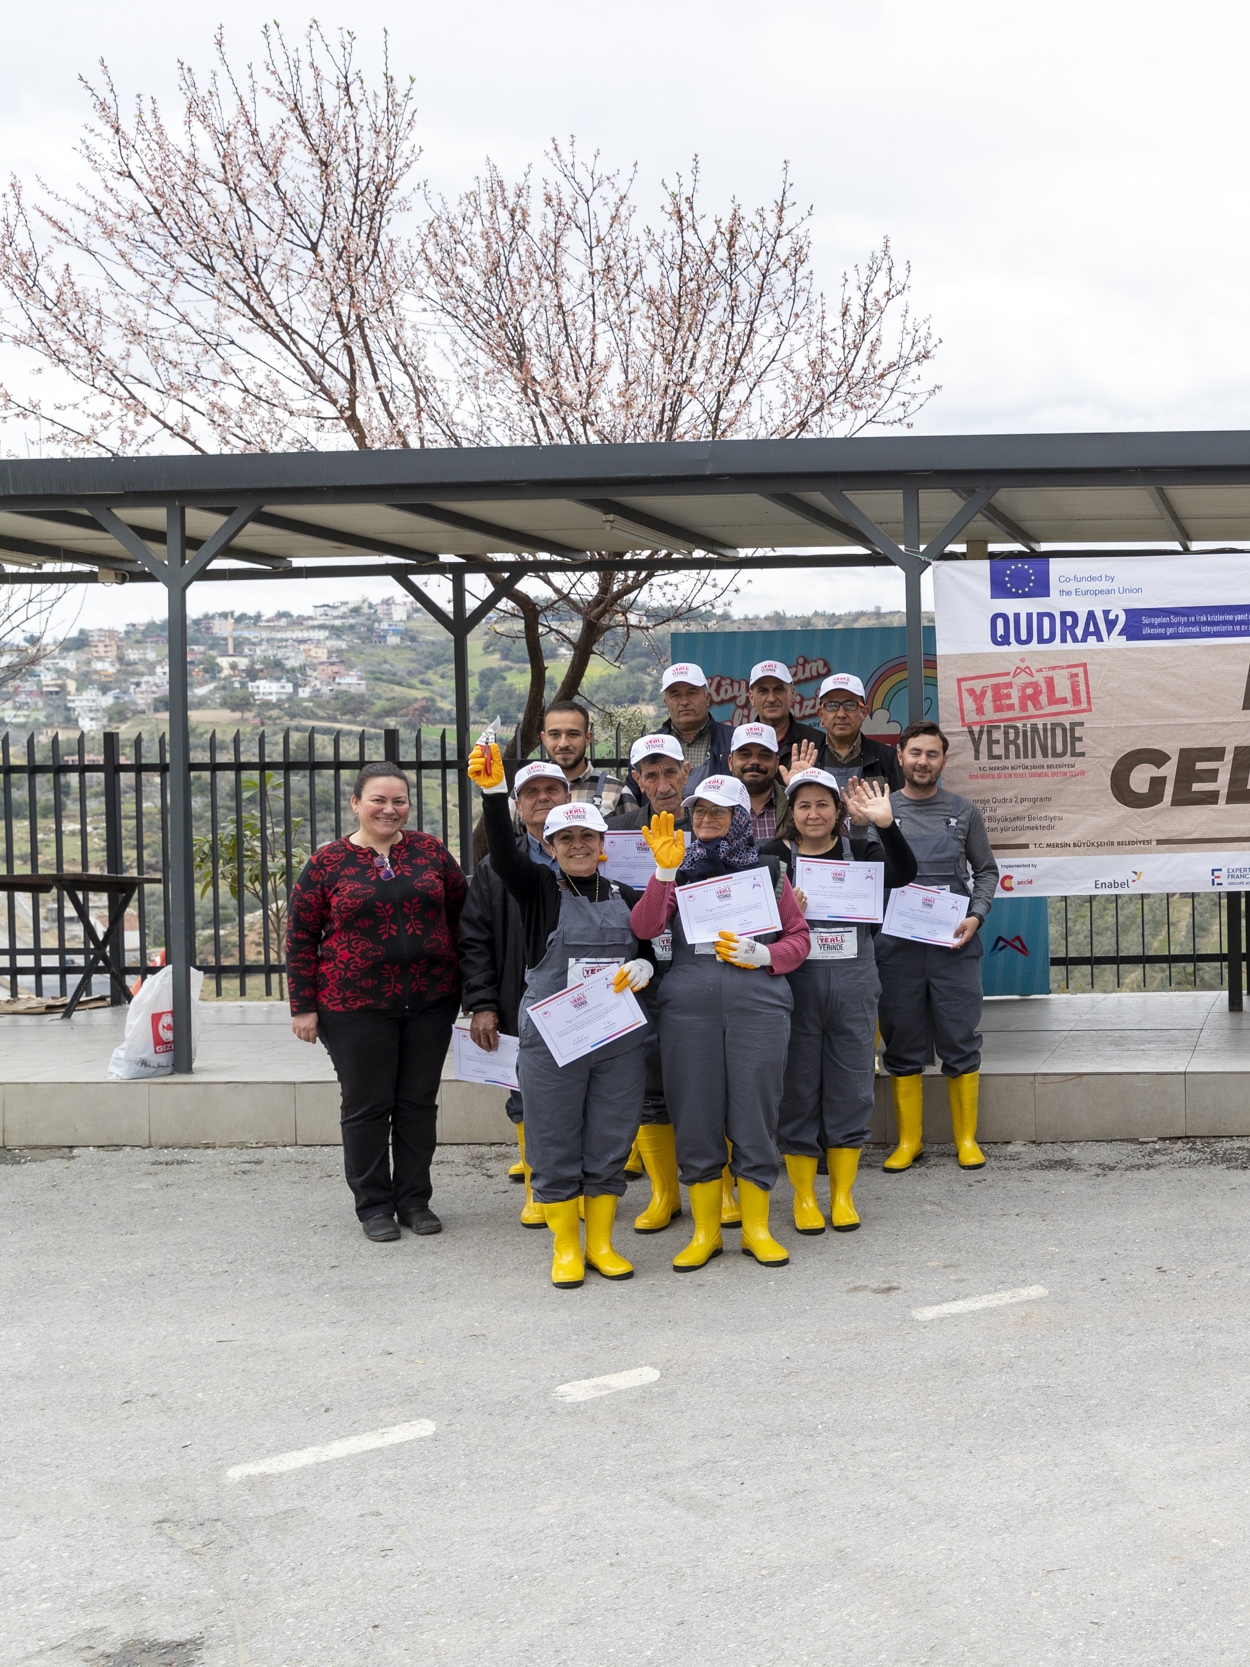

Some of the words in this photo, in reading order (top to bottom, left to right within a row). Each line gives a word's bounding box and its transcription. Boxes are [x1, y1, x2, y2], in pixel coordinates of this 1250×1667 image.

[1058, 574, 1103, 583] Co-funded
[1105, 574, 1115, 583] by
[1059, 589, 1072, 597] the
[1075, 588, 1116, 597] European
[1118, 586, 1143, 594] Union
[1141, 615, 1170, 625] Süregelen
[1170, 614, 1188, 624] Suriye
[1196, 614, 1207, 622] Irak
[1207, 613, 1234, 622] krizlerine
[1234, 613, 1248, 622] yanıt
[1142, 626, 1165, 634] ülkesine
[1166, 627, 1177, 635] geri
[1178, 625, 1200, 633] dönmek
[1200, 624, 1233, 633] isteyenlerin
[967, 722, 1086, 761] YERİNDE
[1011, 763, 1045, 771] BÜYÜKŞEHİR
[1020, 797, 1052, 805] programı
[987, 815, 1026, 824] Büyükşehir
[1027, 813, 1063, 823] Belediyesi
[1000, 824, 1057, 833] yürütülmektedir.
[1046, 840, 1071, 849] MERSİN
[1073, 839, 1115, 849] BÜYÜKŞEHİR
[1117, 838, 1152, 846] BELEDİYESİ
[1094, 879, 1130, 889] Enabel
